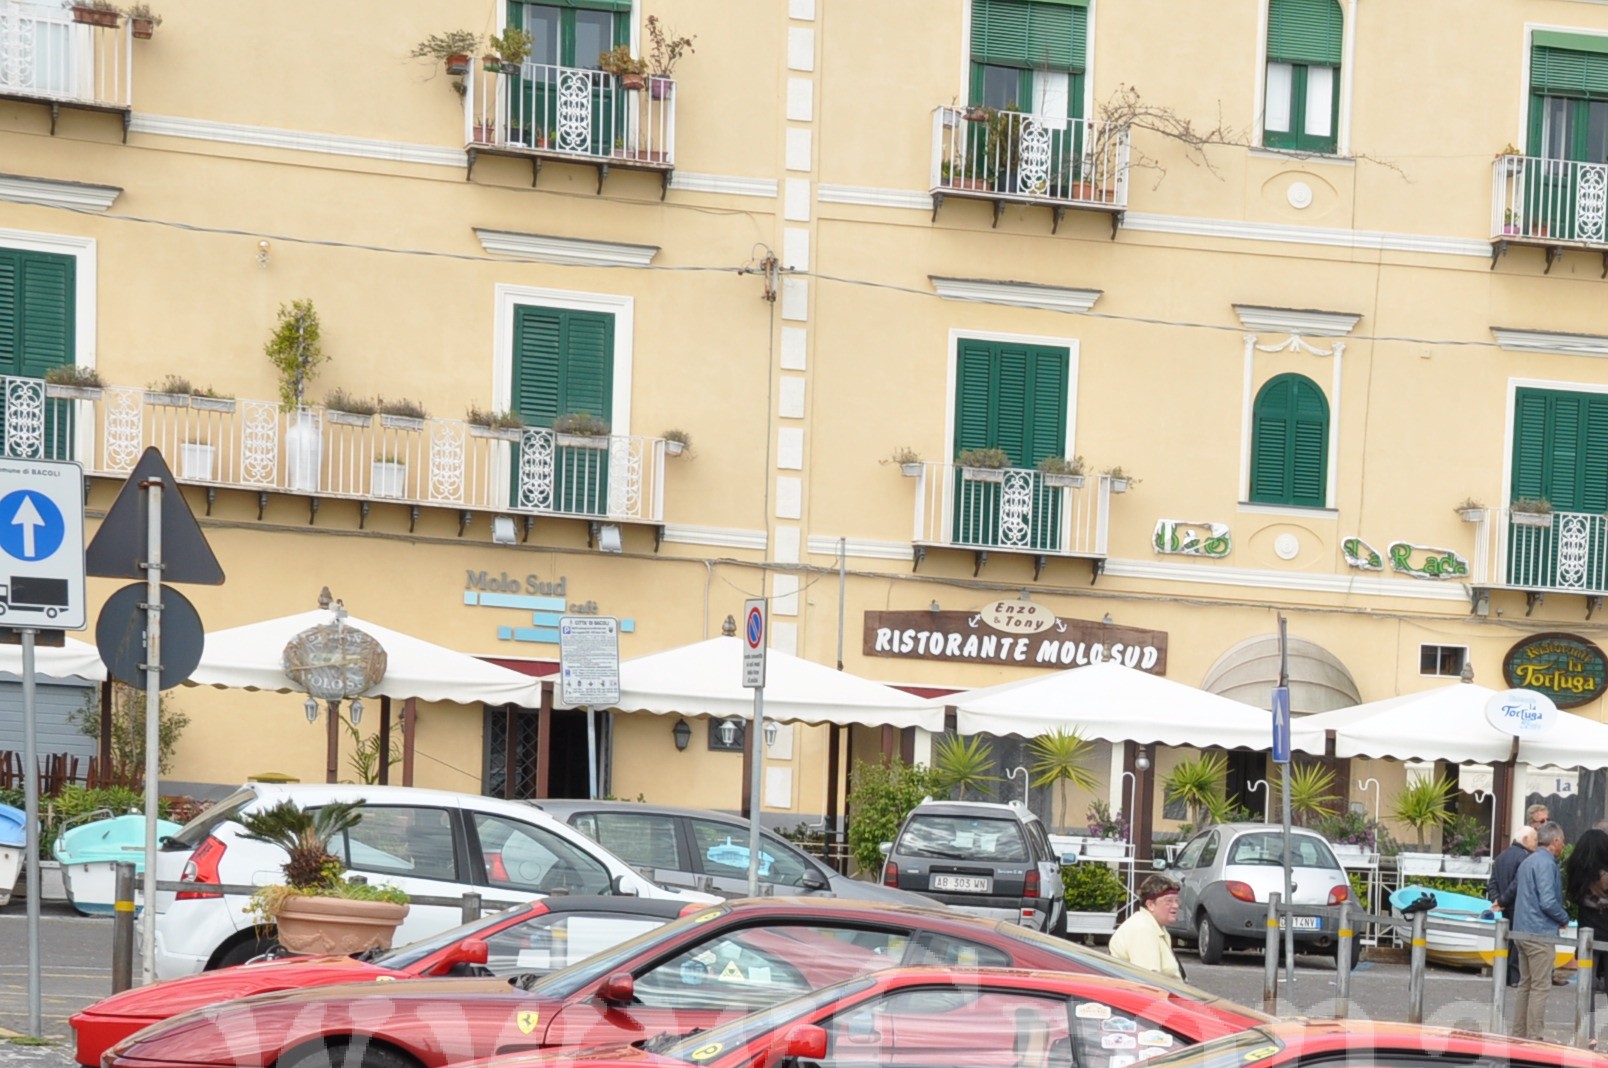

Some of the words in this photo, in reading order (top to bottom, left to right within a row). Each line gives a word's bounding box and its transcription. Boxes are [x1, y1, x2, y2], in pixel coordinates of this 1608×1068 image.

[31, 469, 61, 477] BACOLI
[465, 569, 521, 593] Molo
[526, 573, 567, 596] Sud
[995, 602, 1037, 615] Enzo
[993, 616, 1001, 624] &
[1004, 616, 1045, 631] Tony
[874, 626, 1029, 662] RISTORANTE
[1036, 640, 1105, 667] MOLO
[1108, 643, 1158, 670] SUD
[1526, 642, 1593, 663] Ristorante
[1568, 659, 1583, 673] la
[1516, 658, 1597, 694] Tortuga
[1502, 704, 1543, 721] Tortuga
[1556, 778, 1572, 793] la
[936, 878, 948, 886] AB
[954, 878, 970, 888] 303
[974, 878, 986, 888] WN
